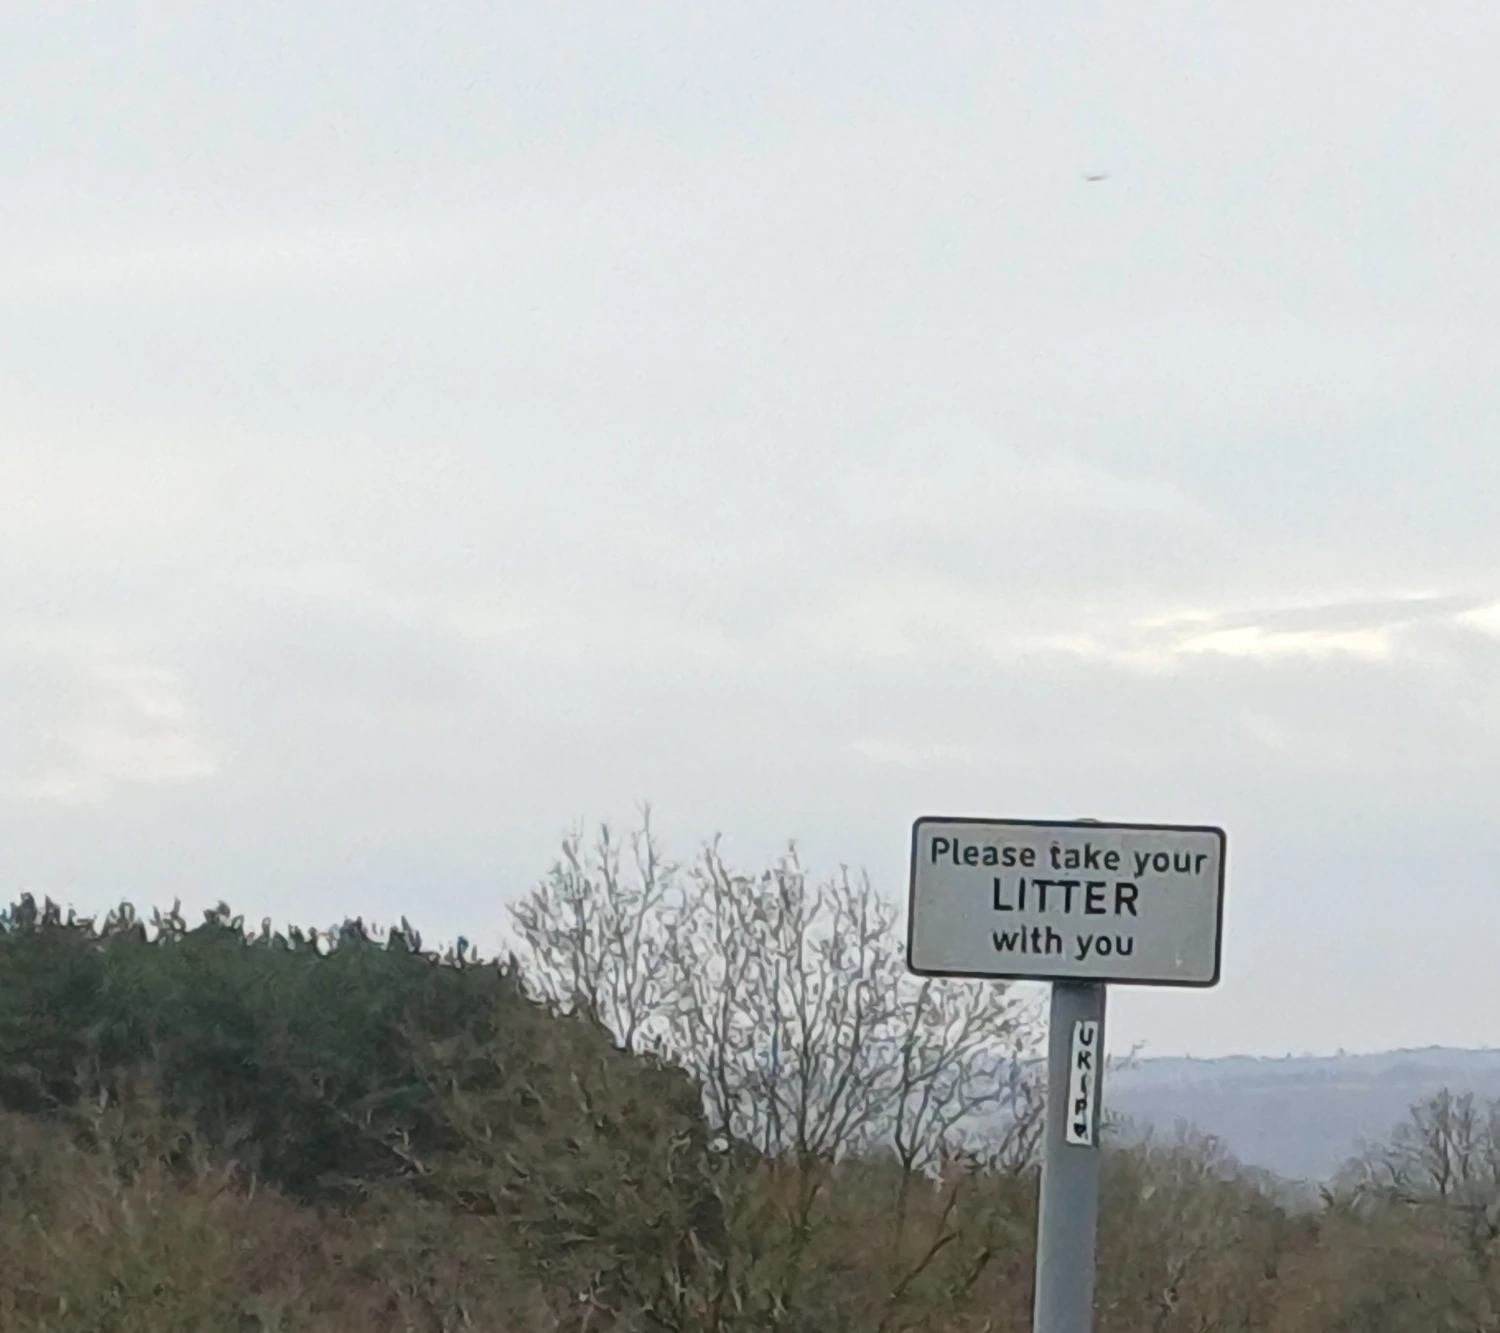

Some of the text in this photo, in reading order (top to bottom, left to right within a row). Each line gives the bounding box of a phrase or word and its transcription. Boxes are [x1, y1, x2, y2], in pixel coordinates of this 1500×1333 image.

[931, 836, 1208, 879] Please take your
[993, 877, 1140, 917] LITTER
[992, 925, 1135, 961] with you
